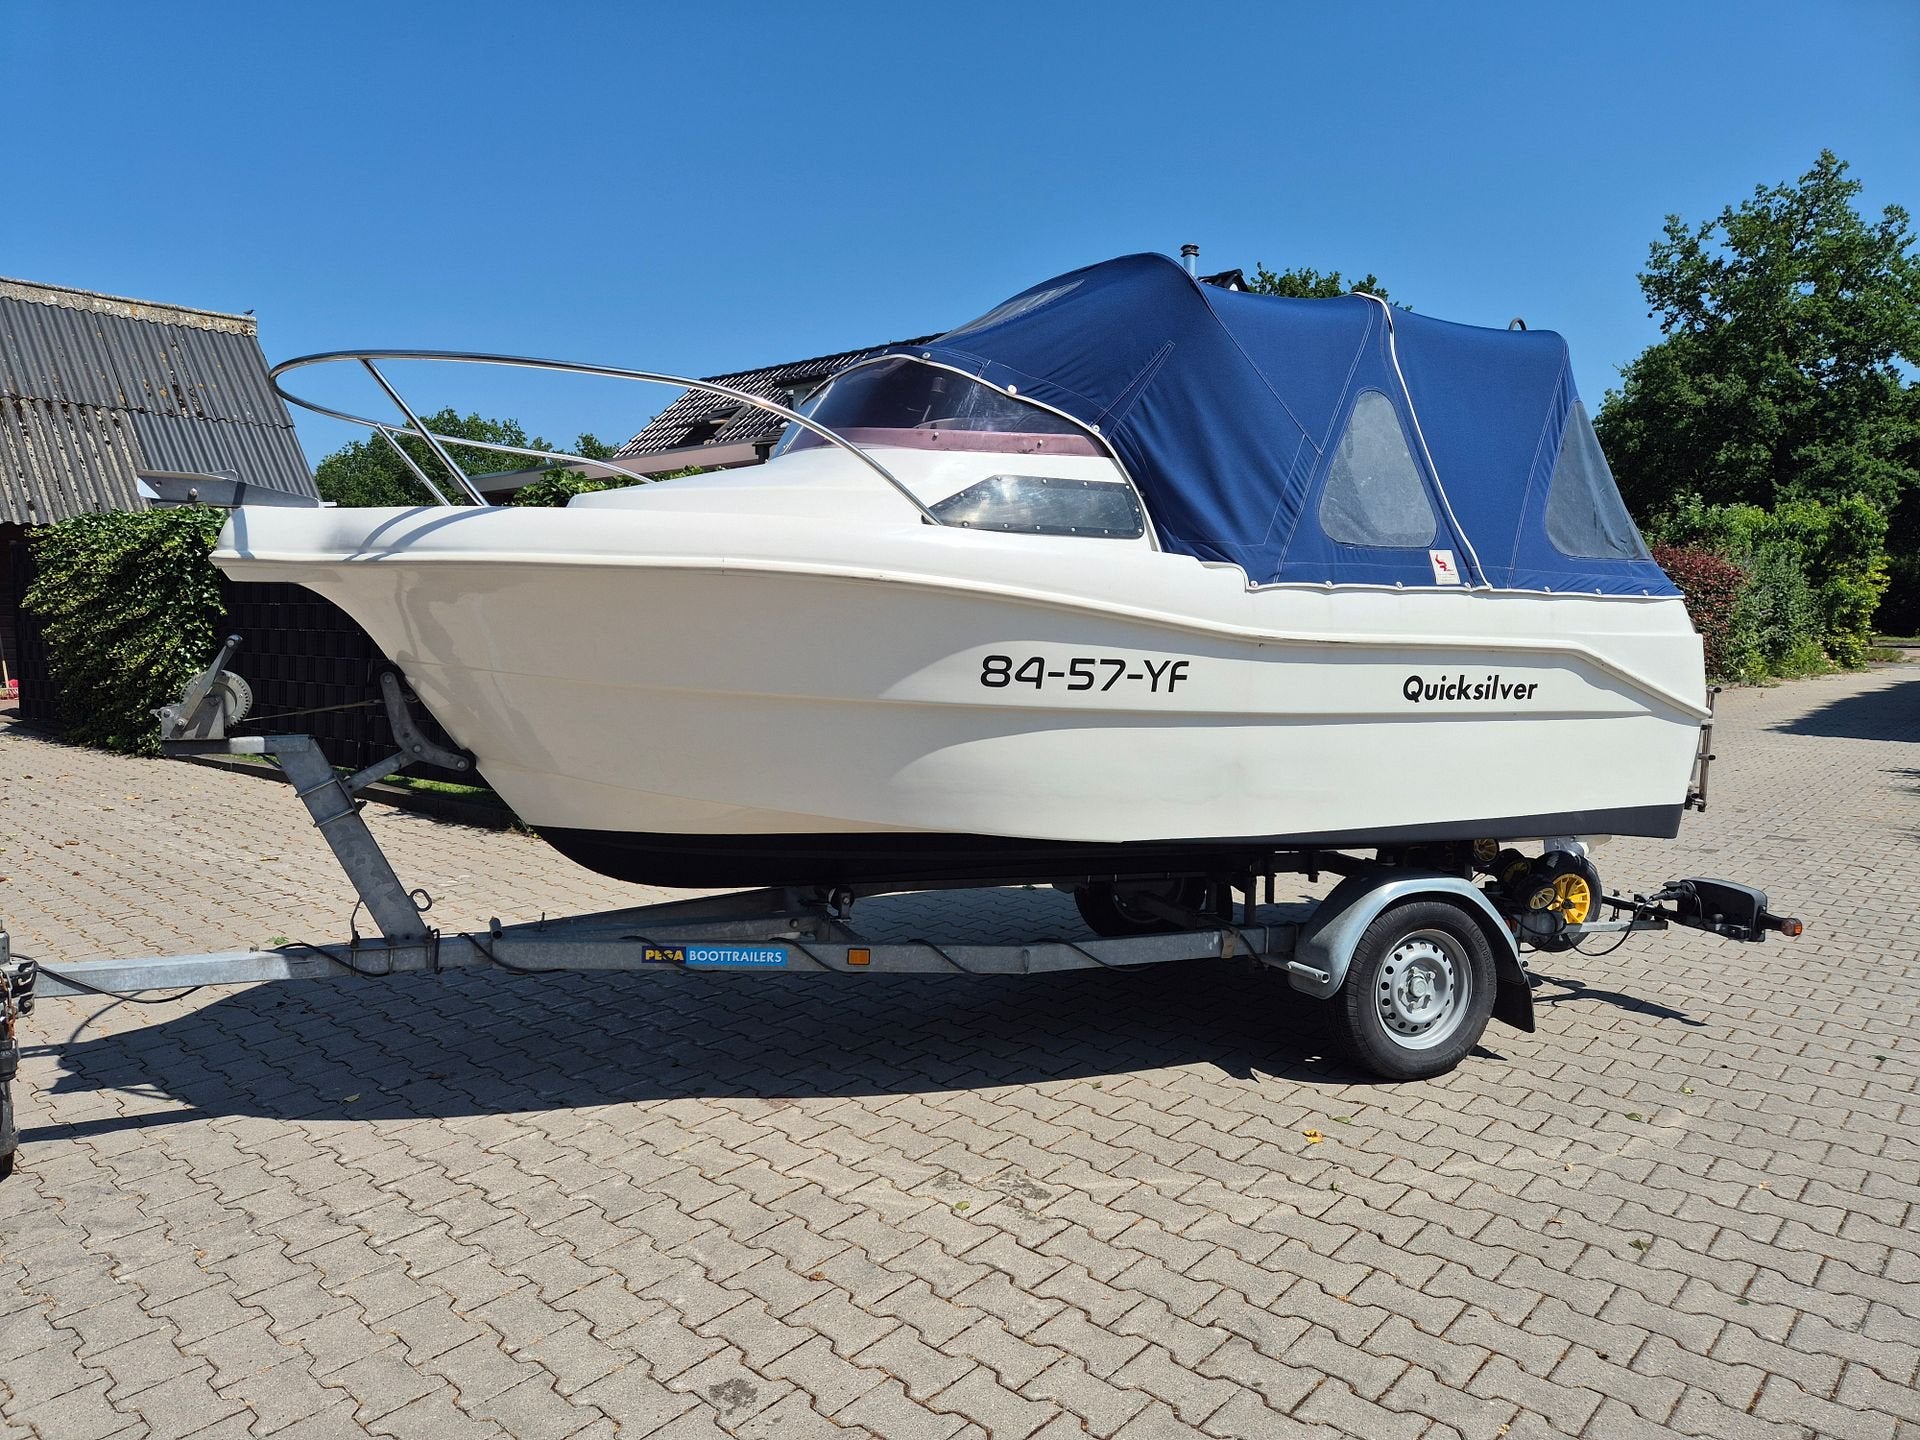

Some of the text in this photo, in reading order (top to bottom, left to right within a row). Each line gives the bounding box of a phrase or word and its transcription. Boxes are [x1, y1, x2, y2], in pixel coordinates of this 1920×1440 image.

[980, 655, 1190, 693] 84-57-YF
[1403, 675, 1538, 703] Quicksilver
[689, 950, 782, 963] BOOTTRAILERS
